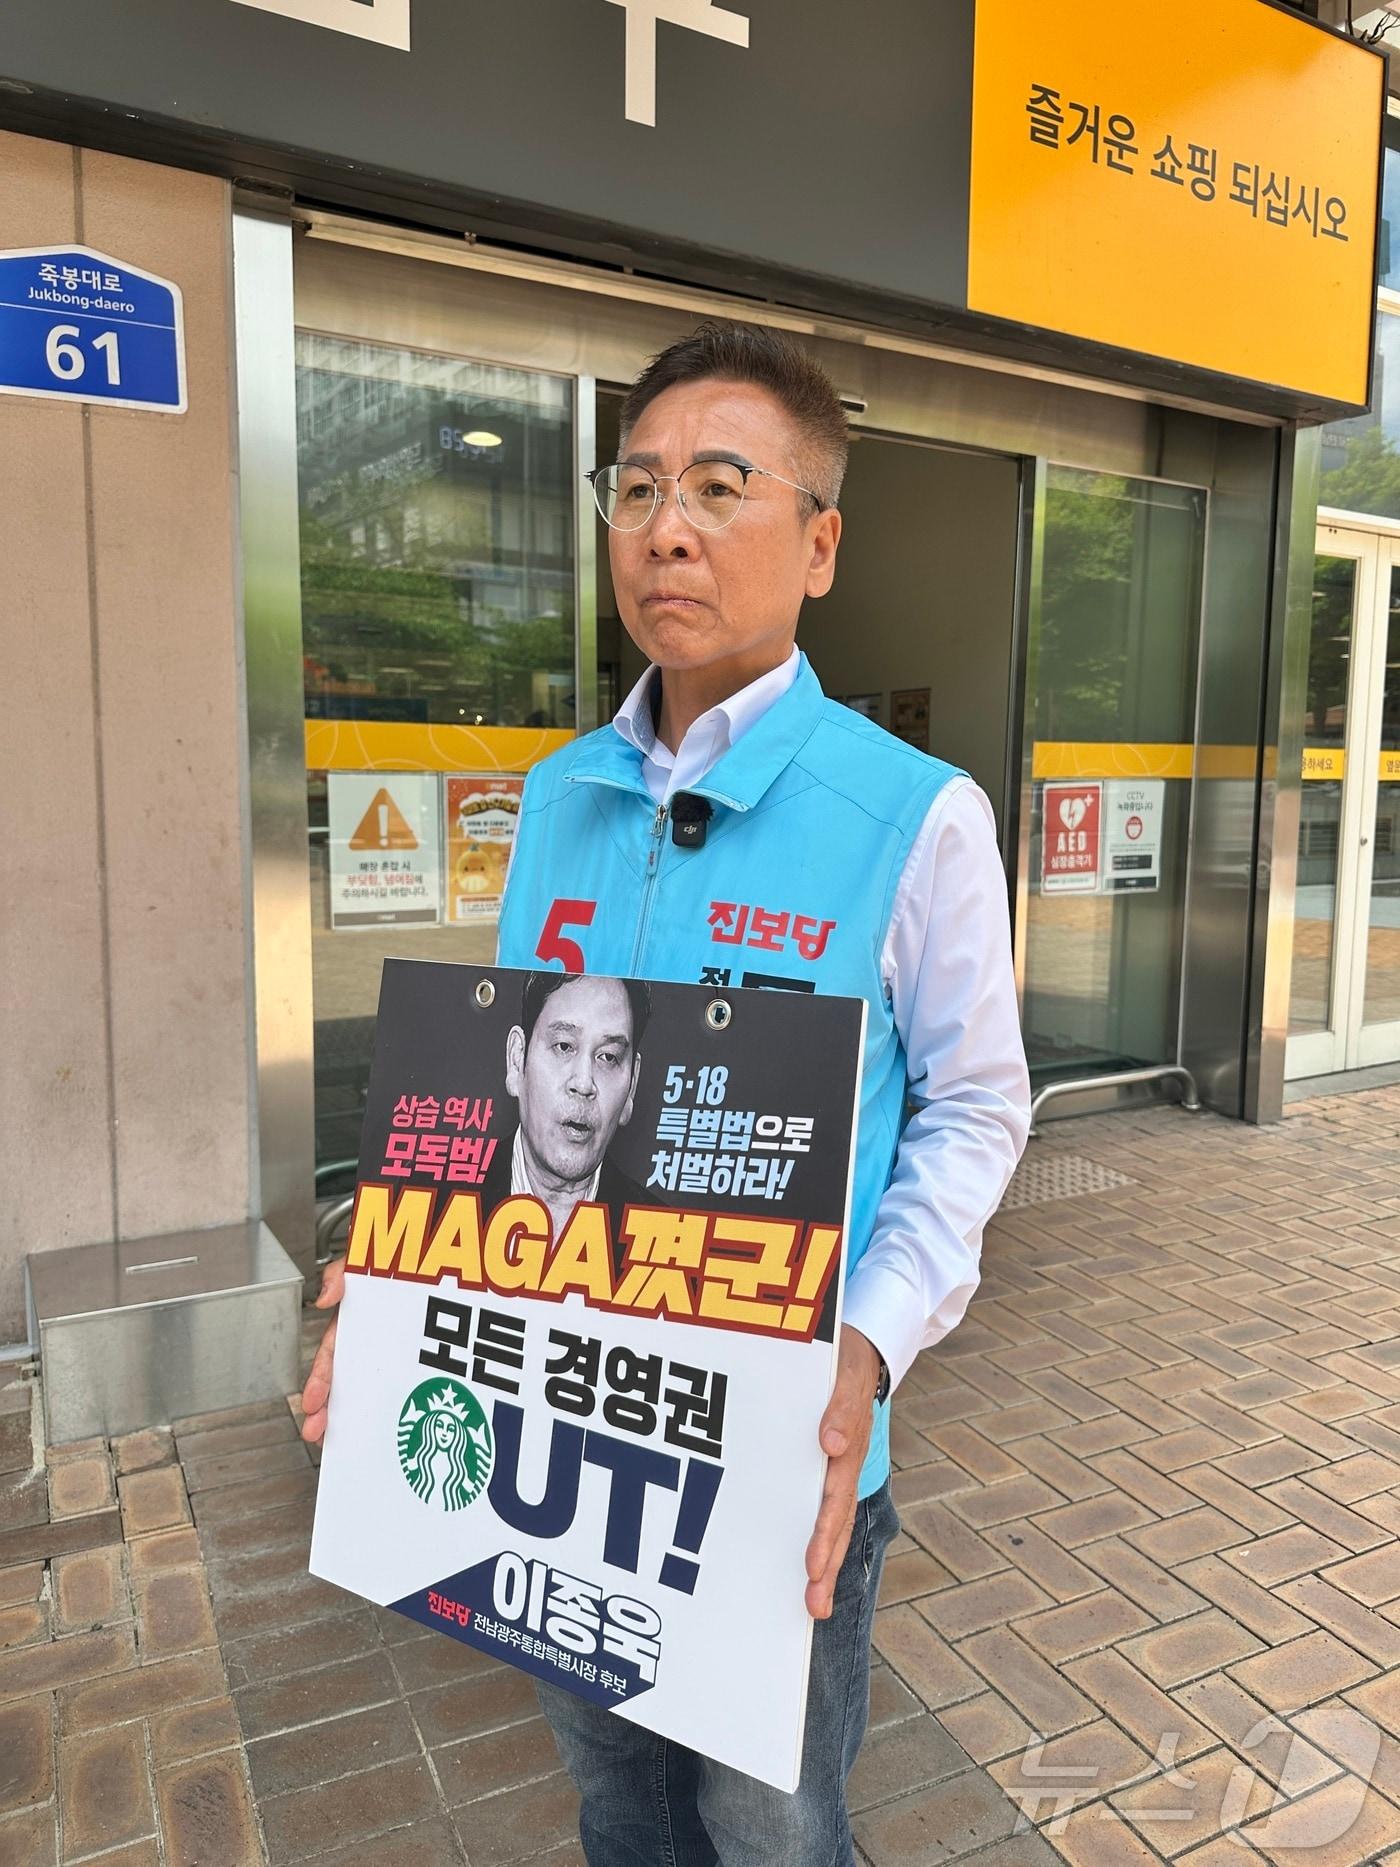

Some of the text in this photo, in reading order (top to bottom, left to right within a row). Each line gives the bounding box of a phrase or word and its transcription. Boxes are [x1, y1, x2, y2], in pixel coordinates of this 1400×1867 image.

[1026, 83, 1349, 242] 즐거운 쇼핑 되십시오
[28, 287, 135, 313] Jukbong-daero
[38, 263, 123, 292] 죽봉대로
[46, 324, 121, 386] 61
[1057, 831, 1087, 853] AED
[534, 899, 597, 974] 5
[707, 900, 836, 961] 진보당
[392, 1095, 493, 1132] 상습 역사
[656, 1107, 815, 1152] 특별법으로
[380, 1132, 498, 1184] 모독범!
[646, 1150, 796, 1200] 처벌하라!
[418, 1296, 728, 1459] 모든 경영권
[427, 1590, 627, 1697] 진보당 전남광주통합특별시장 후보
[492, 1550, 663, 1684] 이종욱
